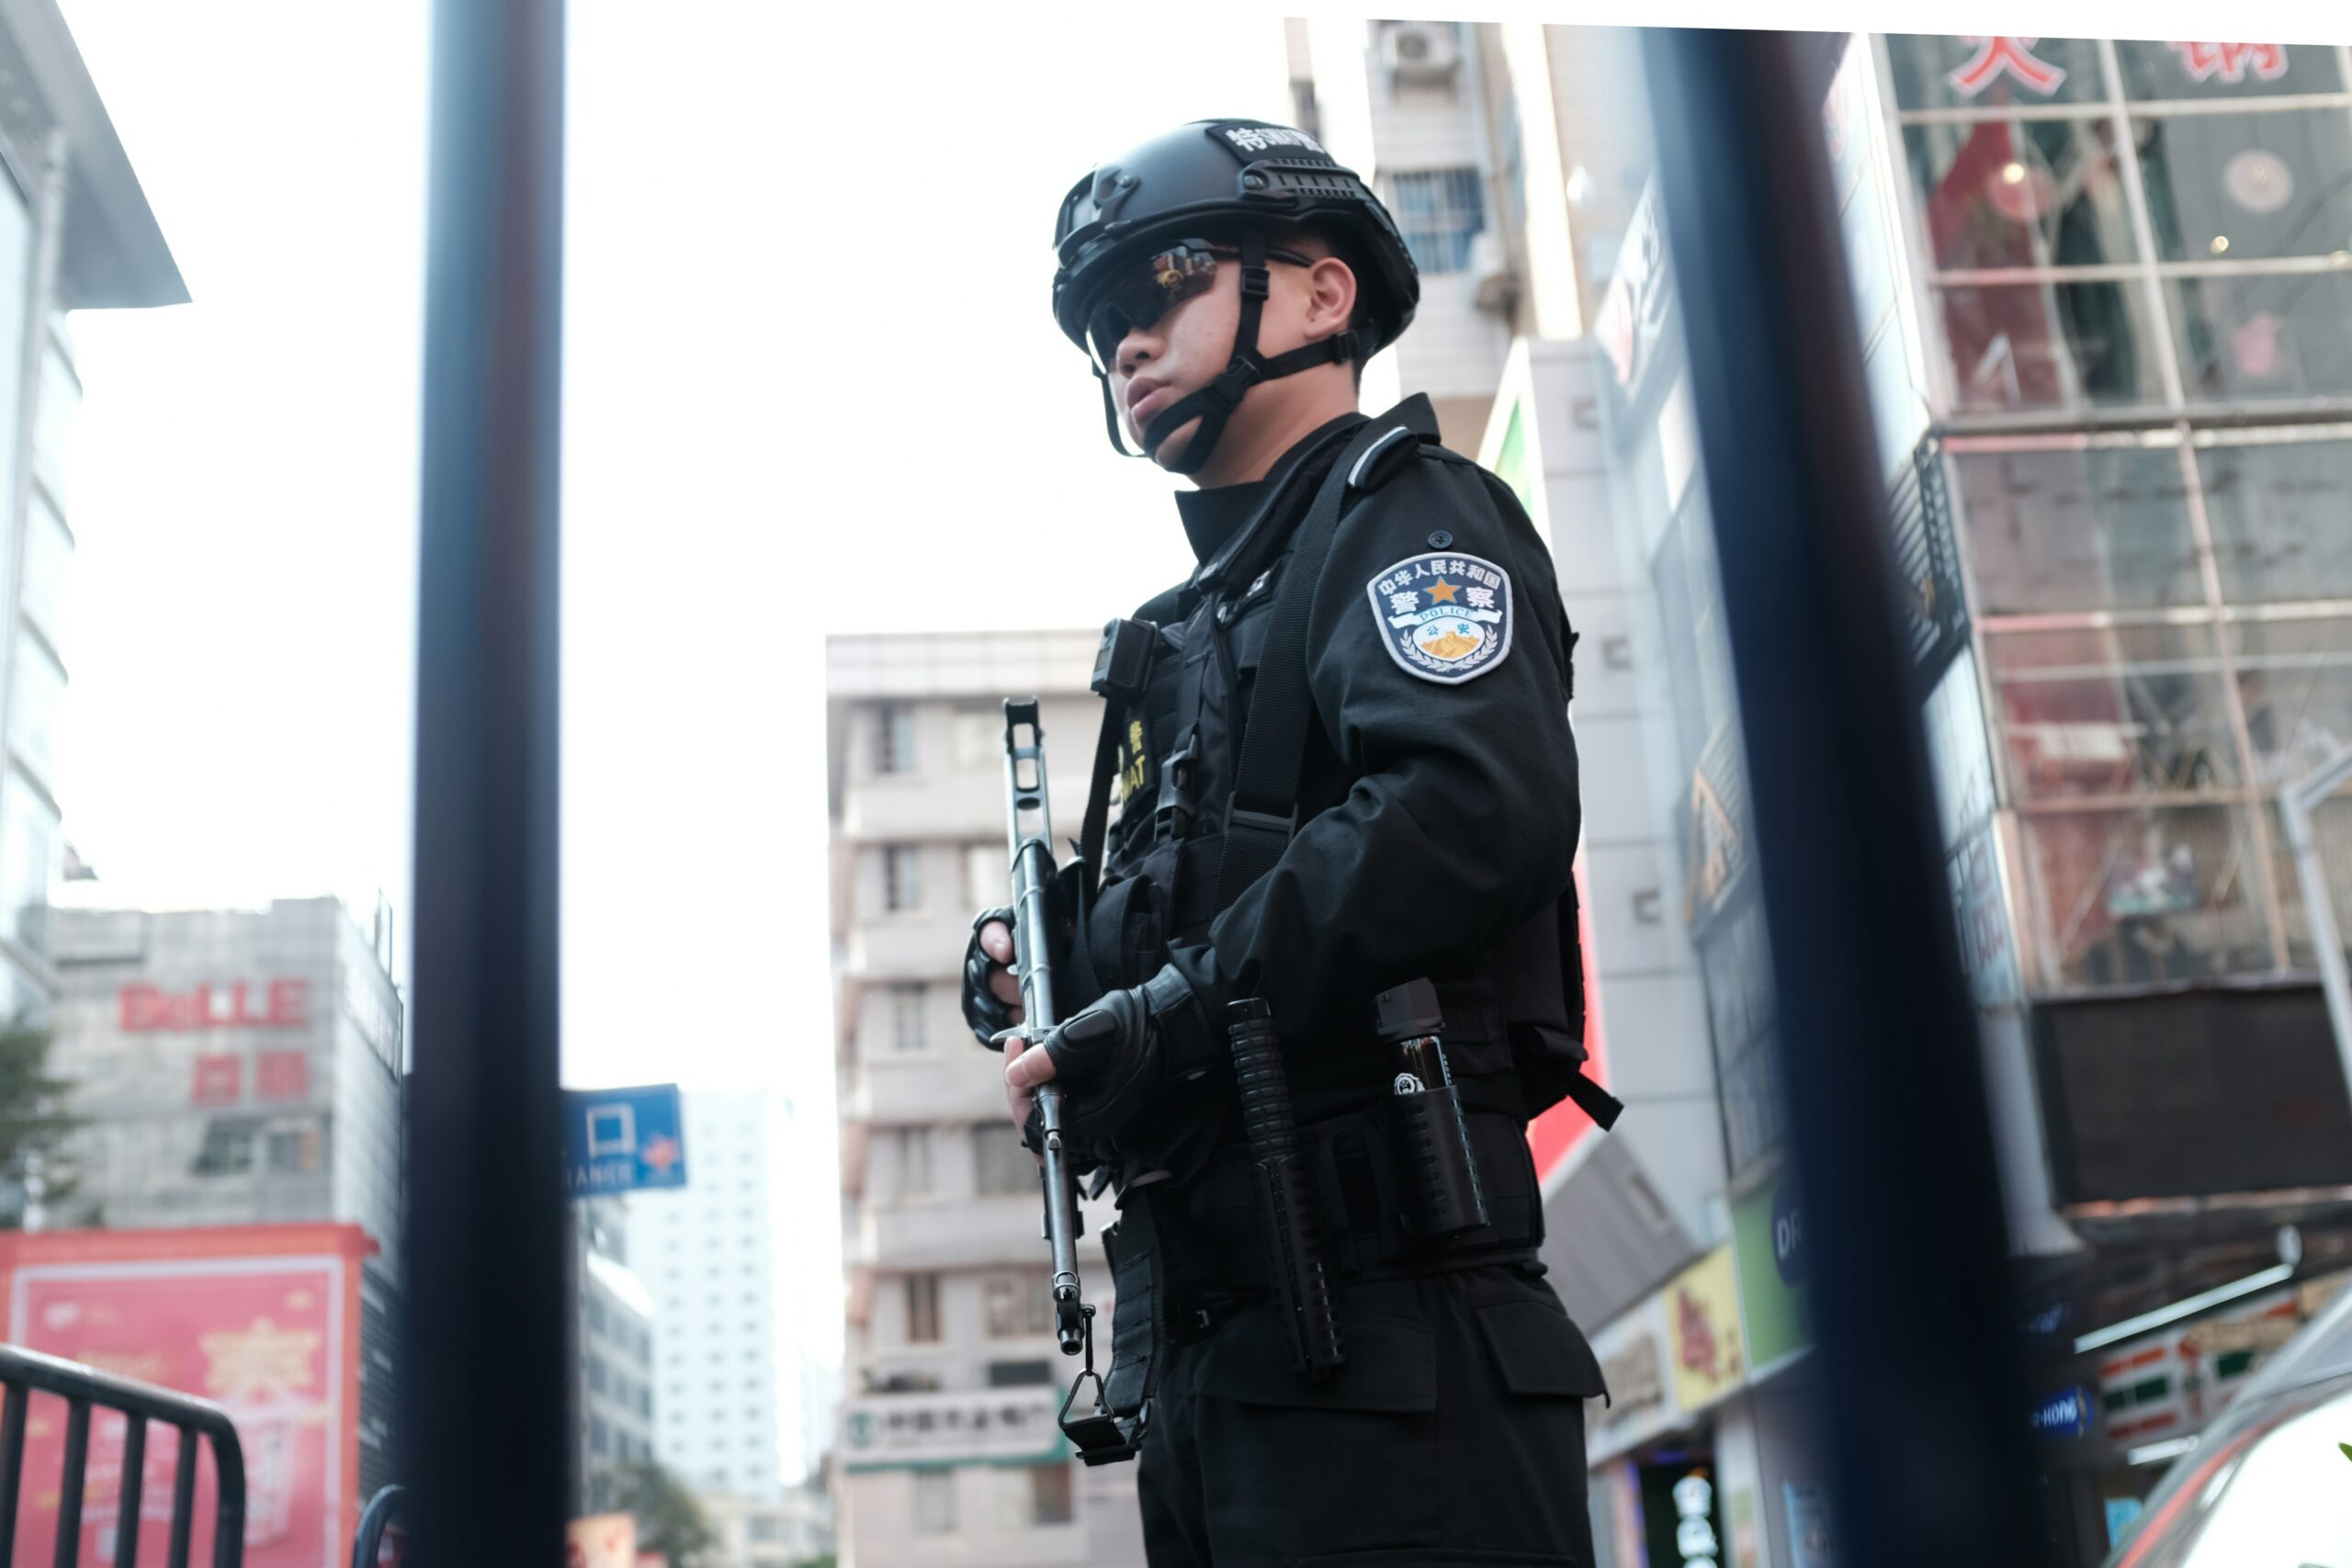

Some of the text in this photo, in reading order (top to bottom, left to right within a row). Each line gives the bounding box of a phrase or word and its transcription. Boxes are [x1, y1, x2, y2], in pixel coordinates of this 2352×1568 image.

[1378, 558, 1501, 596] 中华人民共和国
[1419, 606, 1472, 622] POLICE
